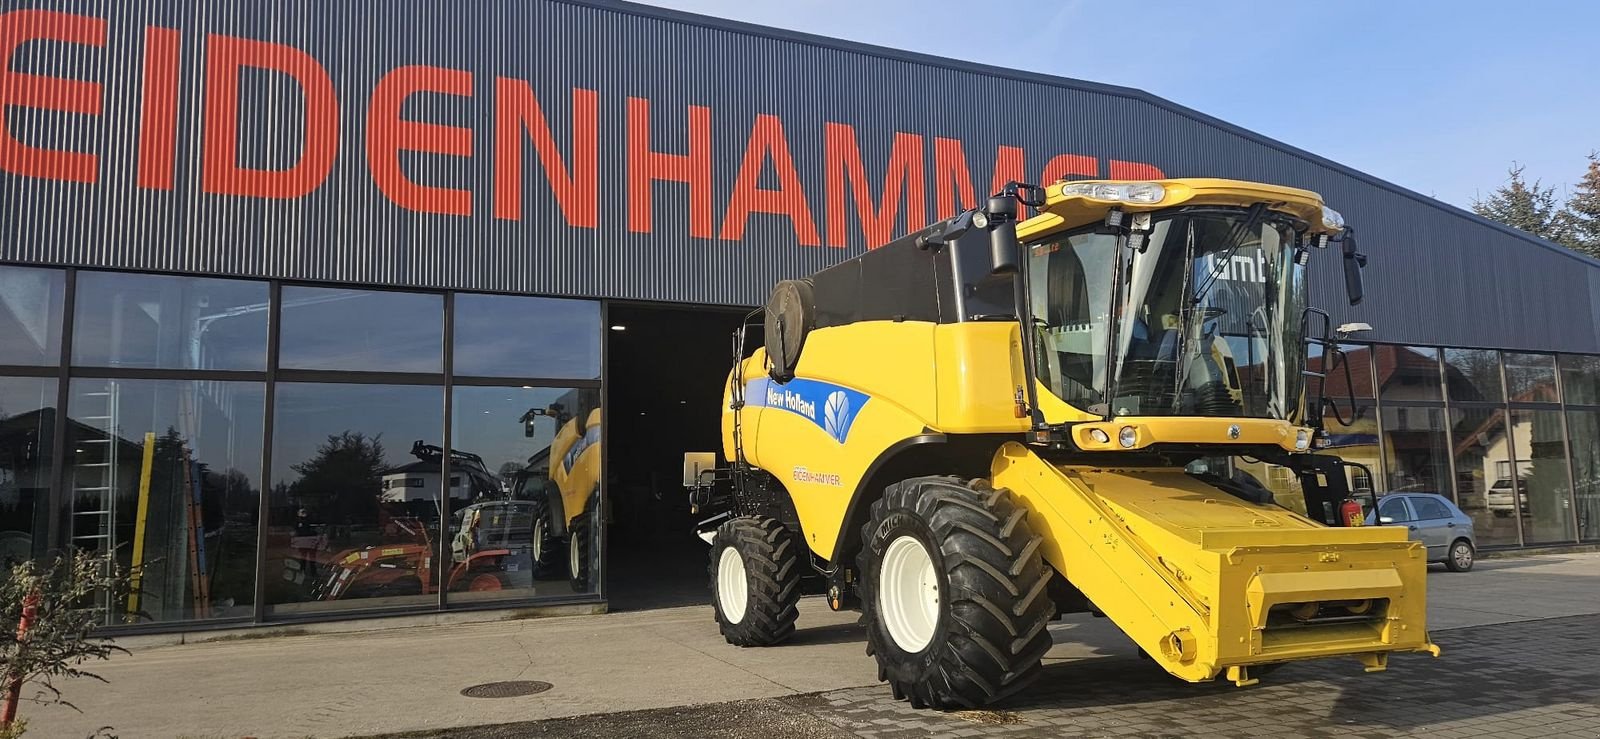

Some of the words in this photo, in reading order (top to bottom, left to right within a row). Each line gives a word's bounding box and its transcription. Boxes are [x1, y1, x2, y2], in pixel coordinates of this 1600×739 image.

[0, 9, 1168, 250] EIDENHAMM
[767, 388, 784, 406] New
[785, 390, 816, 420] Holland
